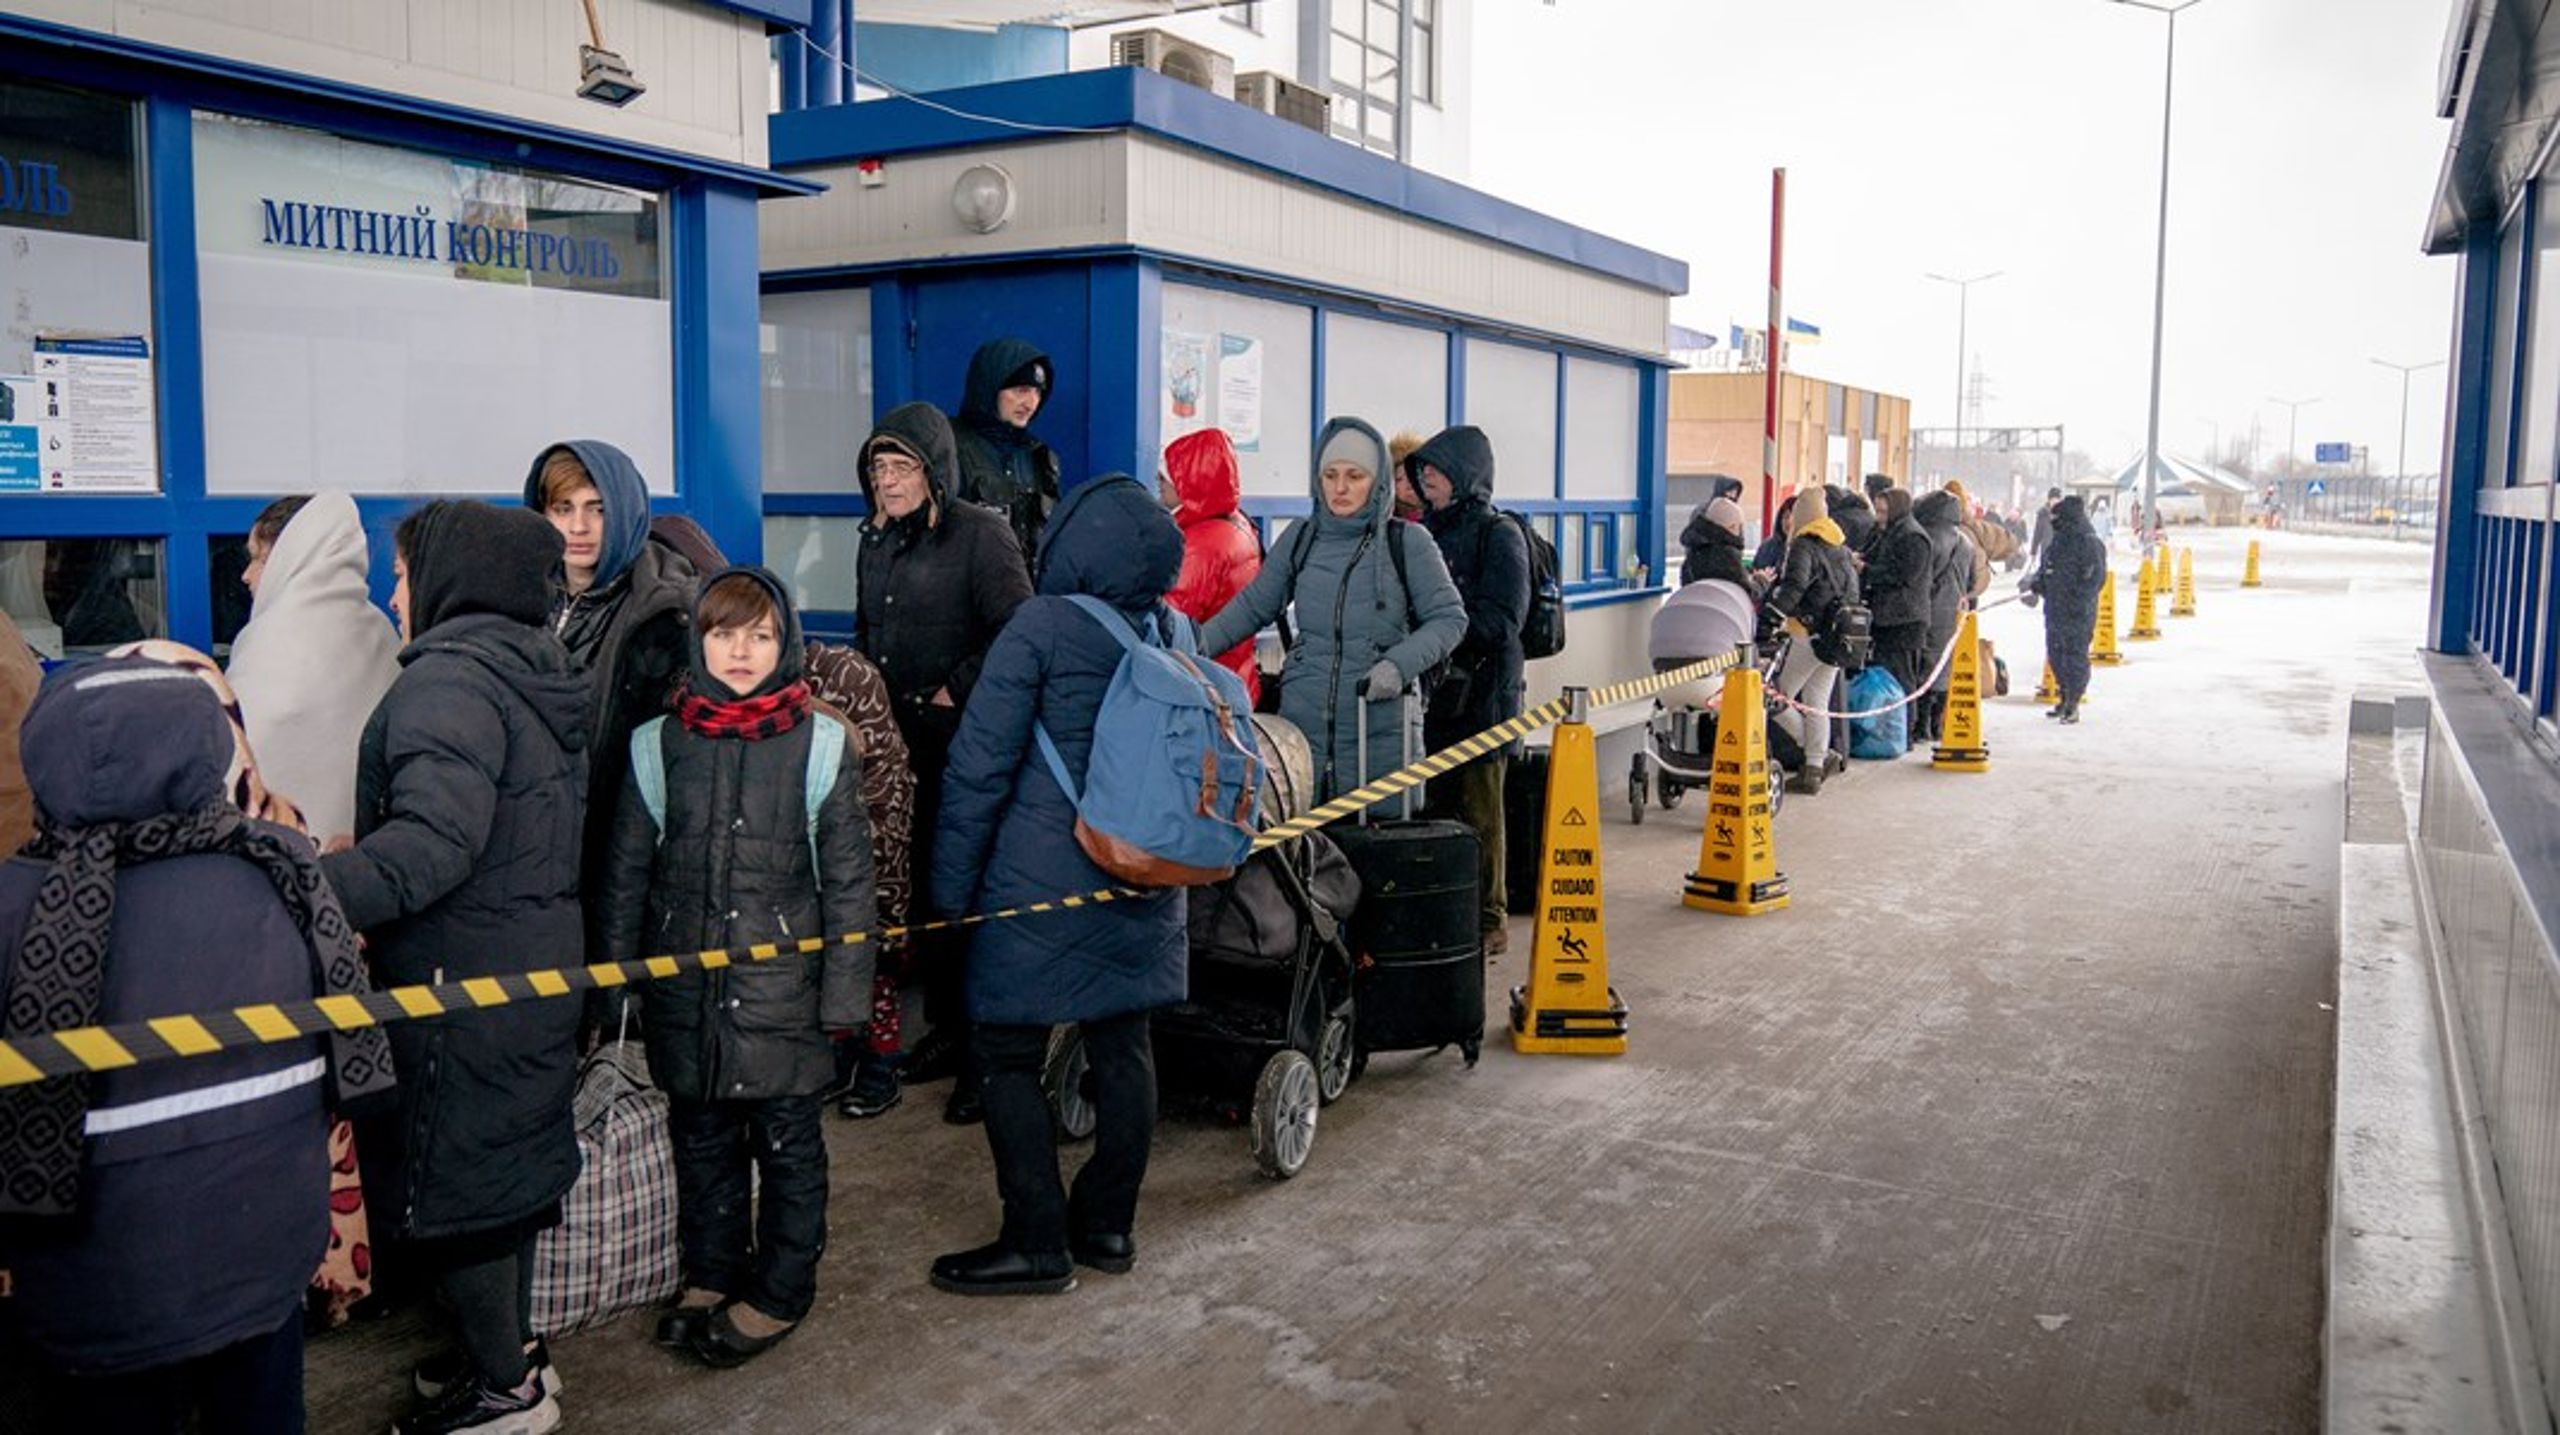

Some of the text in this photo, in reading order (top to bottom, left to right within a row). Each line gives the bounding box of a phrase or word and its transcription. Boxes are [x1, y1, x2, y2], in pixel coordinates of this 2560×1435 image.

[262, 199, 619, 279] МИТНИЙ КОНТРОЛЬ
[1554, 848, 1593, 866] CAUTION
[1551, 878, 1595, 896] CUIDADO
[1548, 906, 1598, 923] ATTENTION
